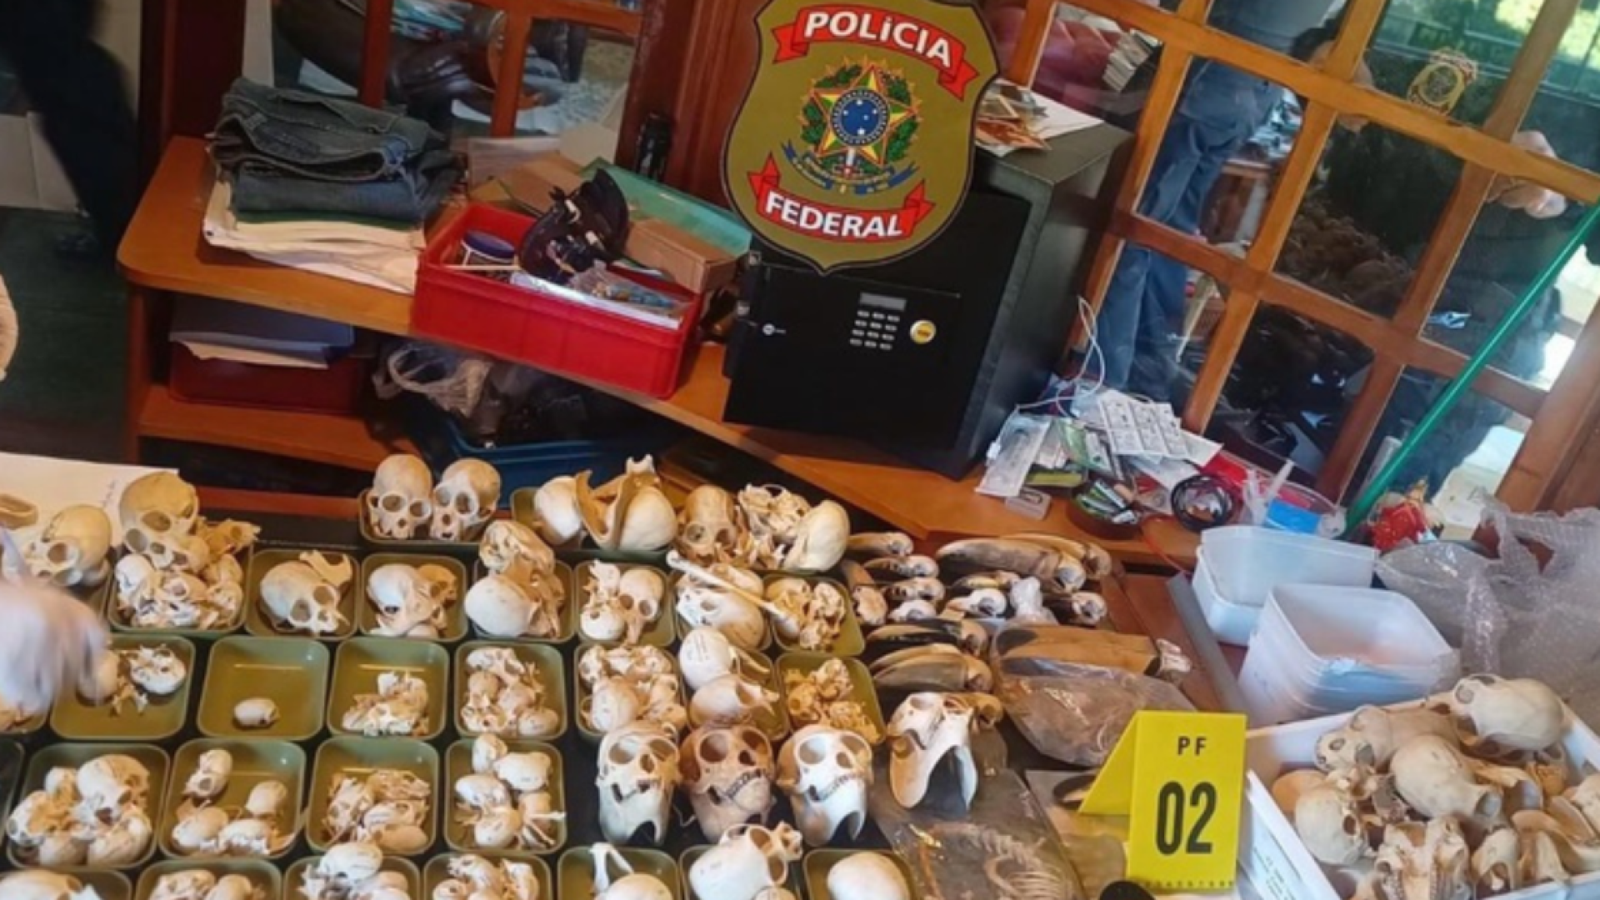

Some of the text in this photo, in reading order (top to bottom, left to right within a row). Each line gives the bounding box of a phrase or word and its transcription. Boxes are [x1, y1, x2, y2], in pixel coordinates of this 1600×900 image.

[805, 12, 950, 67] POLÍCIA
[766, 191, 902, 238] FEDERAL
[1156, 780, 1217, 856] 02
